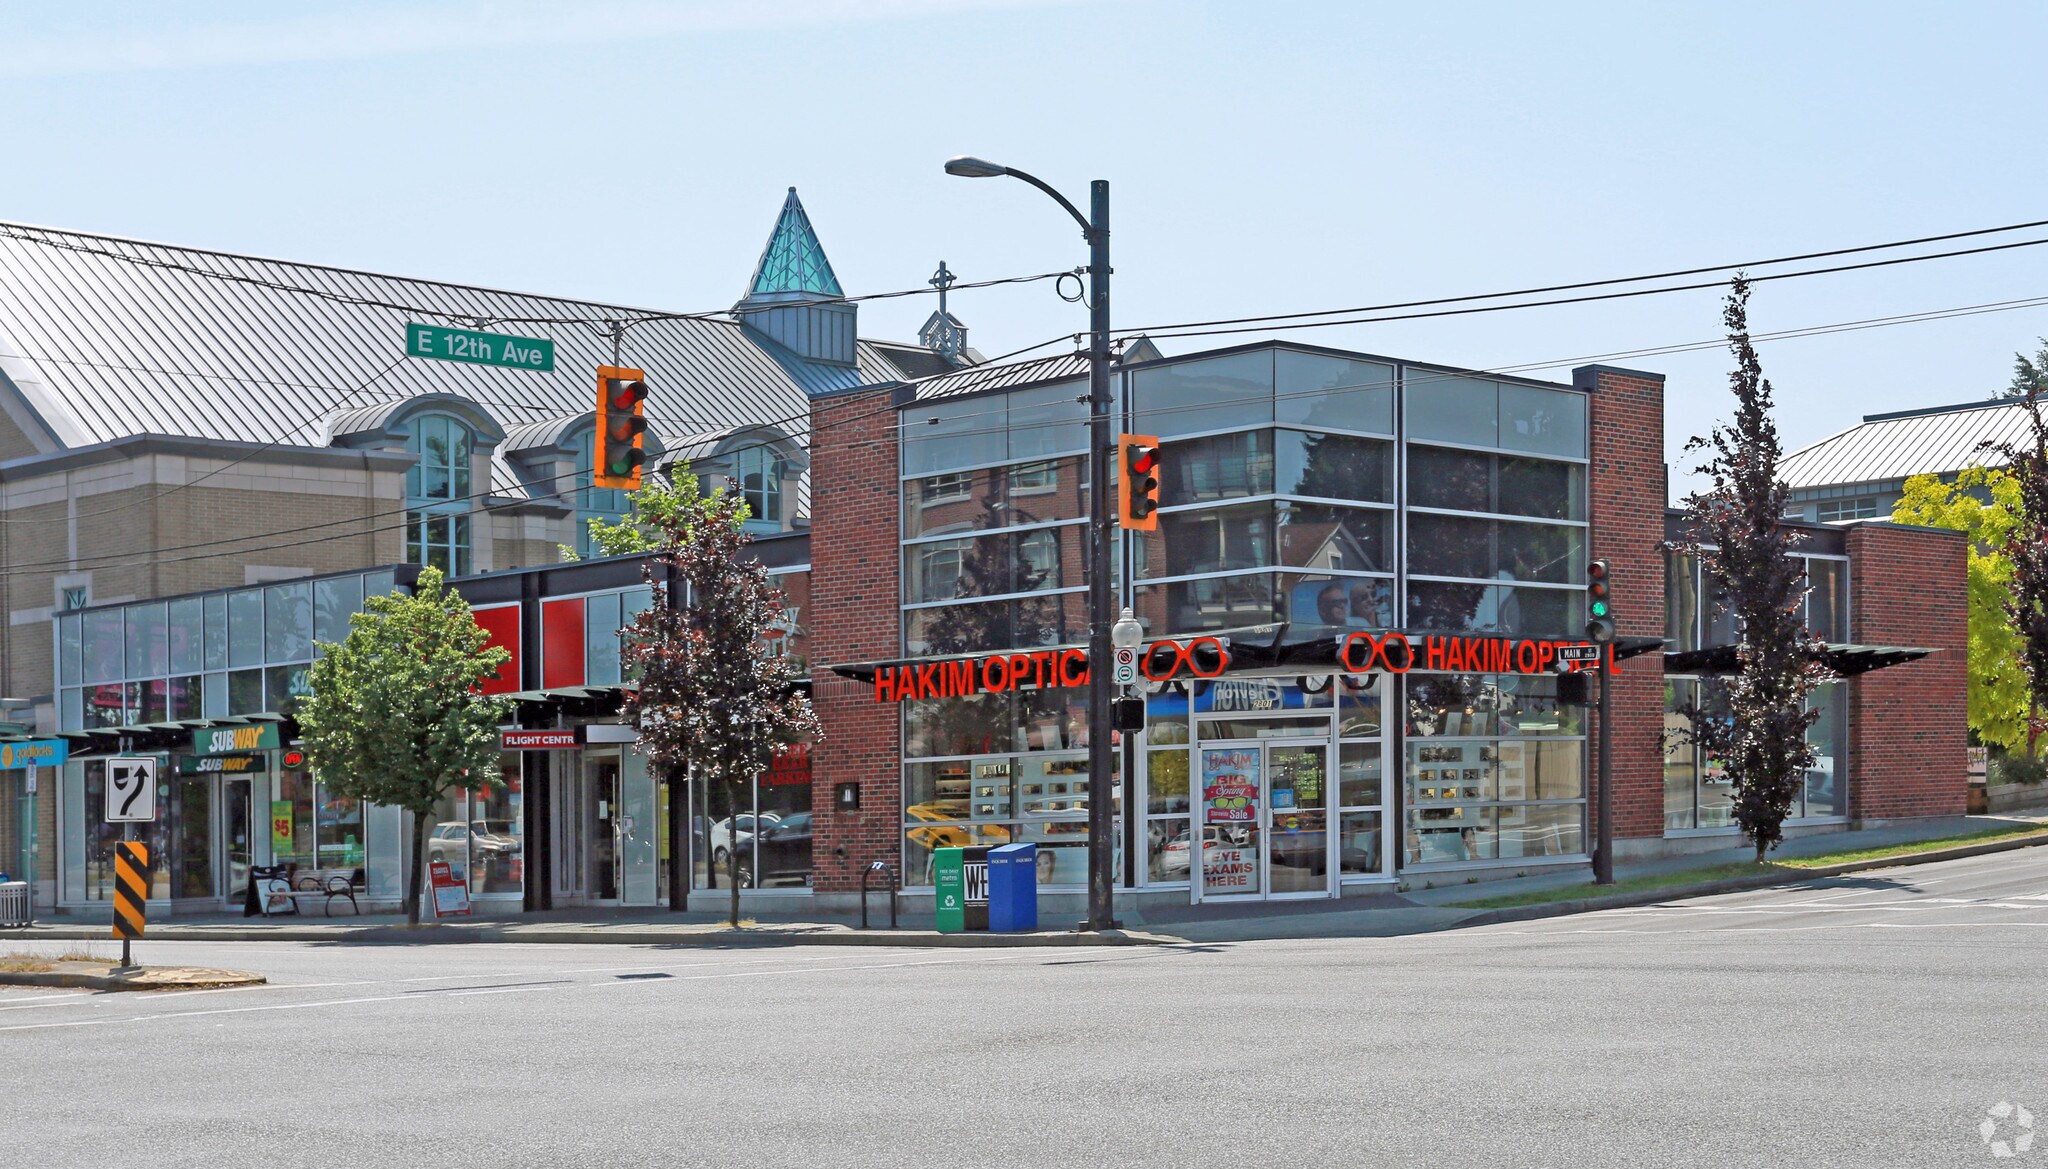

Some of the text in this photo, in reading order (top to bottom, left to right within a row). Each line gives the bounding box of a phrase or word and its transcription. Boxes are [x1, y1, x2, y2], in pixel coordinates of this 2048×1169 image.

[418, 330, 543, 365] E 12th Ave
[1427, 635, 1511, 673] HAKIM
[1564, 649, 1581, 658] MAIN
[875, 648, 1091, 703] HAKIM OPTIC
[1254, 700, 1272, 708] 2801
[208, 725, 265, 753] SUBWAY
[506, 735, 575, 745] FLIGHT CENTR
[196, 757, 254, 772] SUBWAY
[1209, 752, 1252, 771] HAKIM
[1216, 774, 1246, 785] BIG
[1229, 809, 1248, 819] Sale
[275, 819, 289, 837] $5
[1212, 851, 1240, 862] EYE
[1206, 875, 1247, 888] HERE
